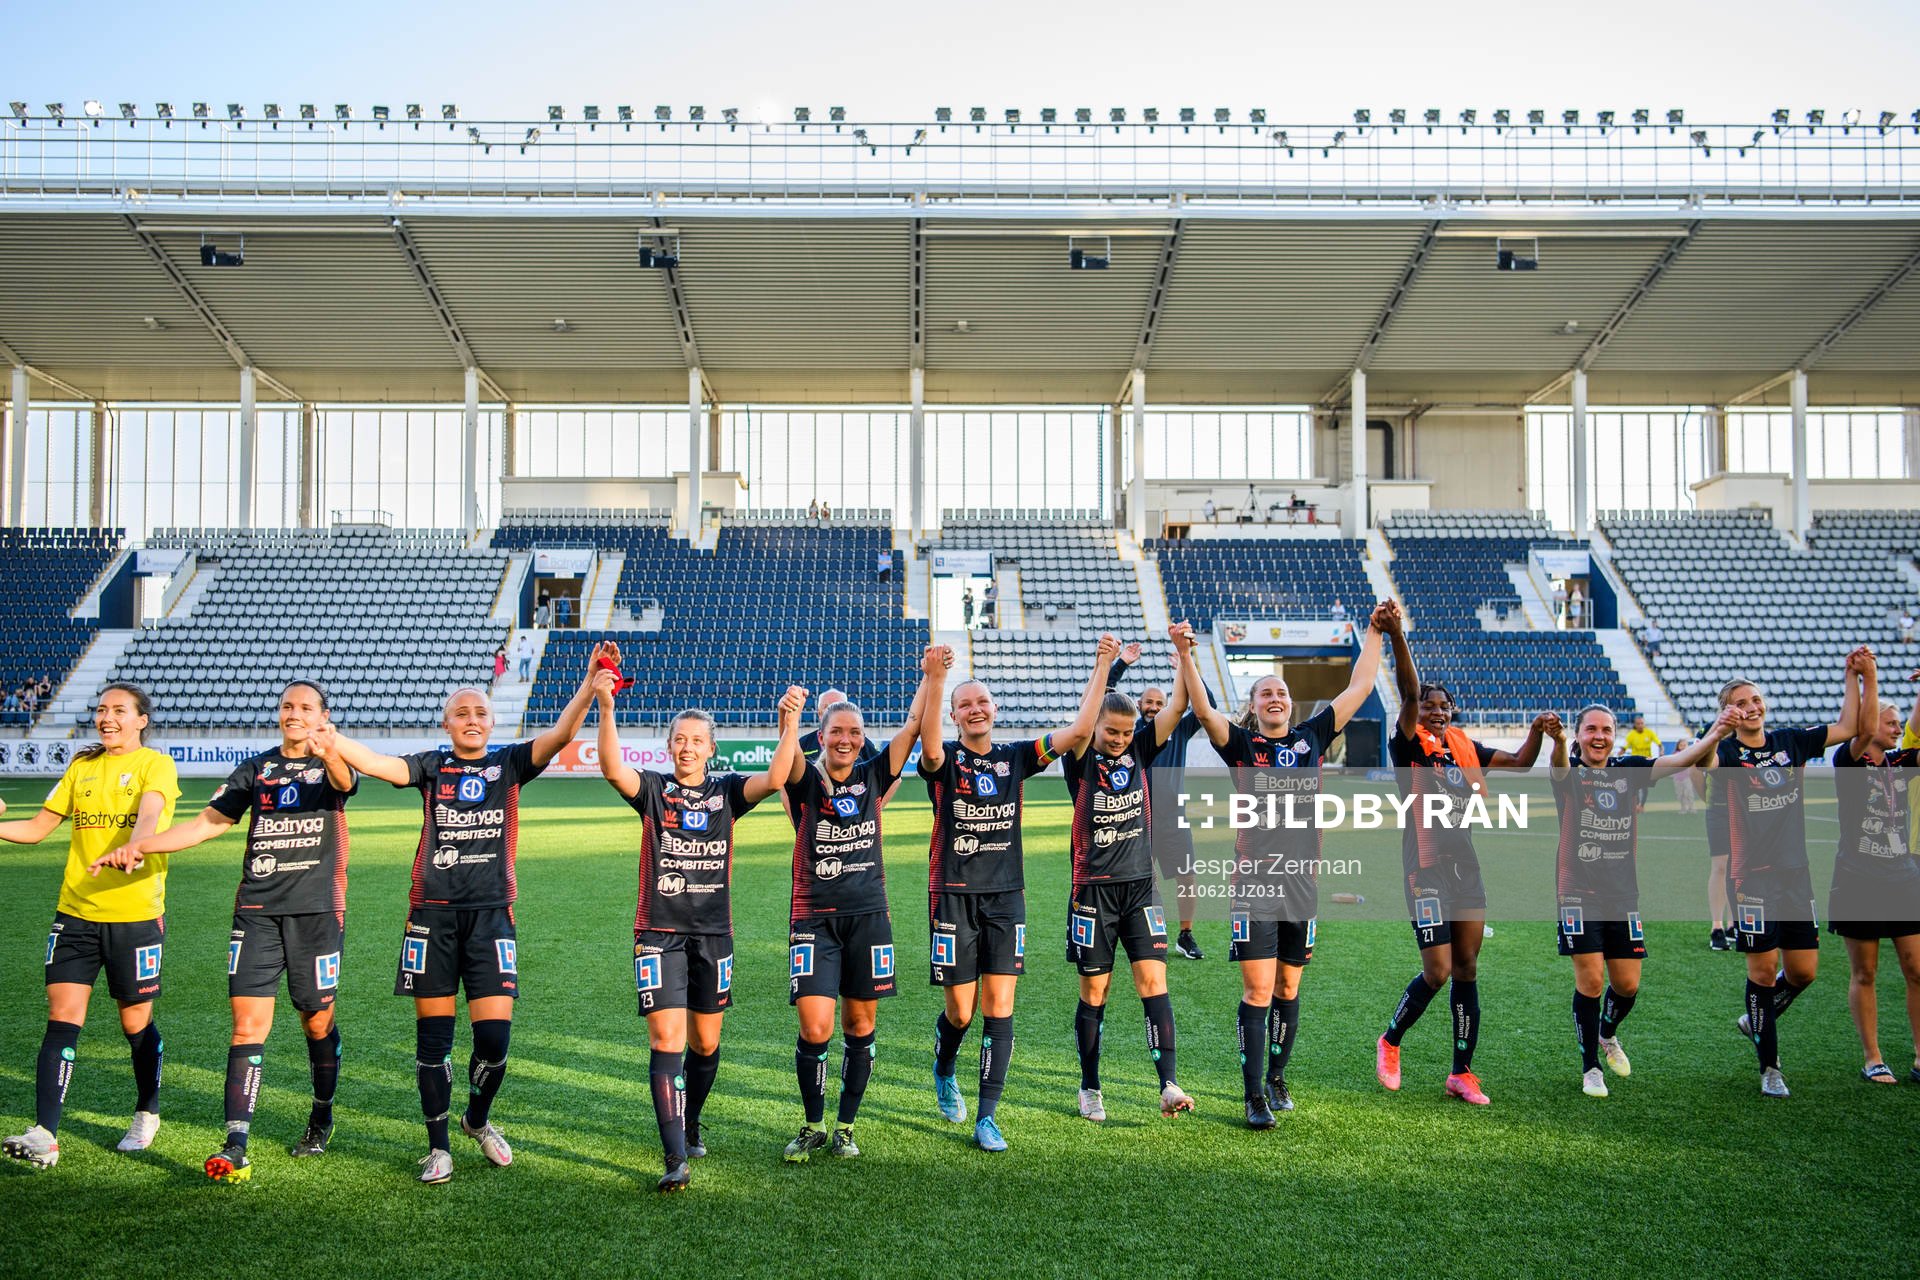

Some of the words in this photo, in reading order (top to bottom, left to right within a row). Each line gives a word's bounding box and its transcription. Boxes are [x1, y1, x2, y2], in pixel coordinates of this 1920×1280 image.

[1268, 776, 1318, 790] Botrygg
[448, 809, 504, 824] Botrygg
[968, 802, 1016, 818] Botrygg
[1093, 807, 1142, 824] COMBITEC
[264, 817, 324, 834] Botrygg
[831, 820, 876, 839] Botrygg
[956, 820, 1014, 832] COMBITECH
[439, 828, 502, 841] COMBITECH
[253, 836, 322, 851] COMBITECH
[672, 838, 726, 856] Botrygg
[816, 839, 874, 854] COMBITECH
[660, 858, 724, 870] COMBITECH
[1422, 928, 1433, 943] 27
[934, 966, 944, 981] 15
[404, 974, 413, 990] 21
[641, 992, 654, 1008] 23
[1272, 1009, 1280, 1042] LUNDBERGS
[1456, 1004, 1464, 1038] LUNDBERGS
[248, 1067, 262, 1113] LUNDBERGS
